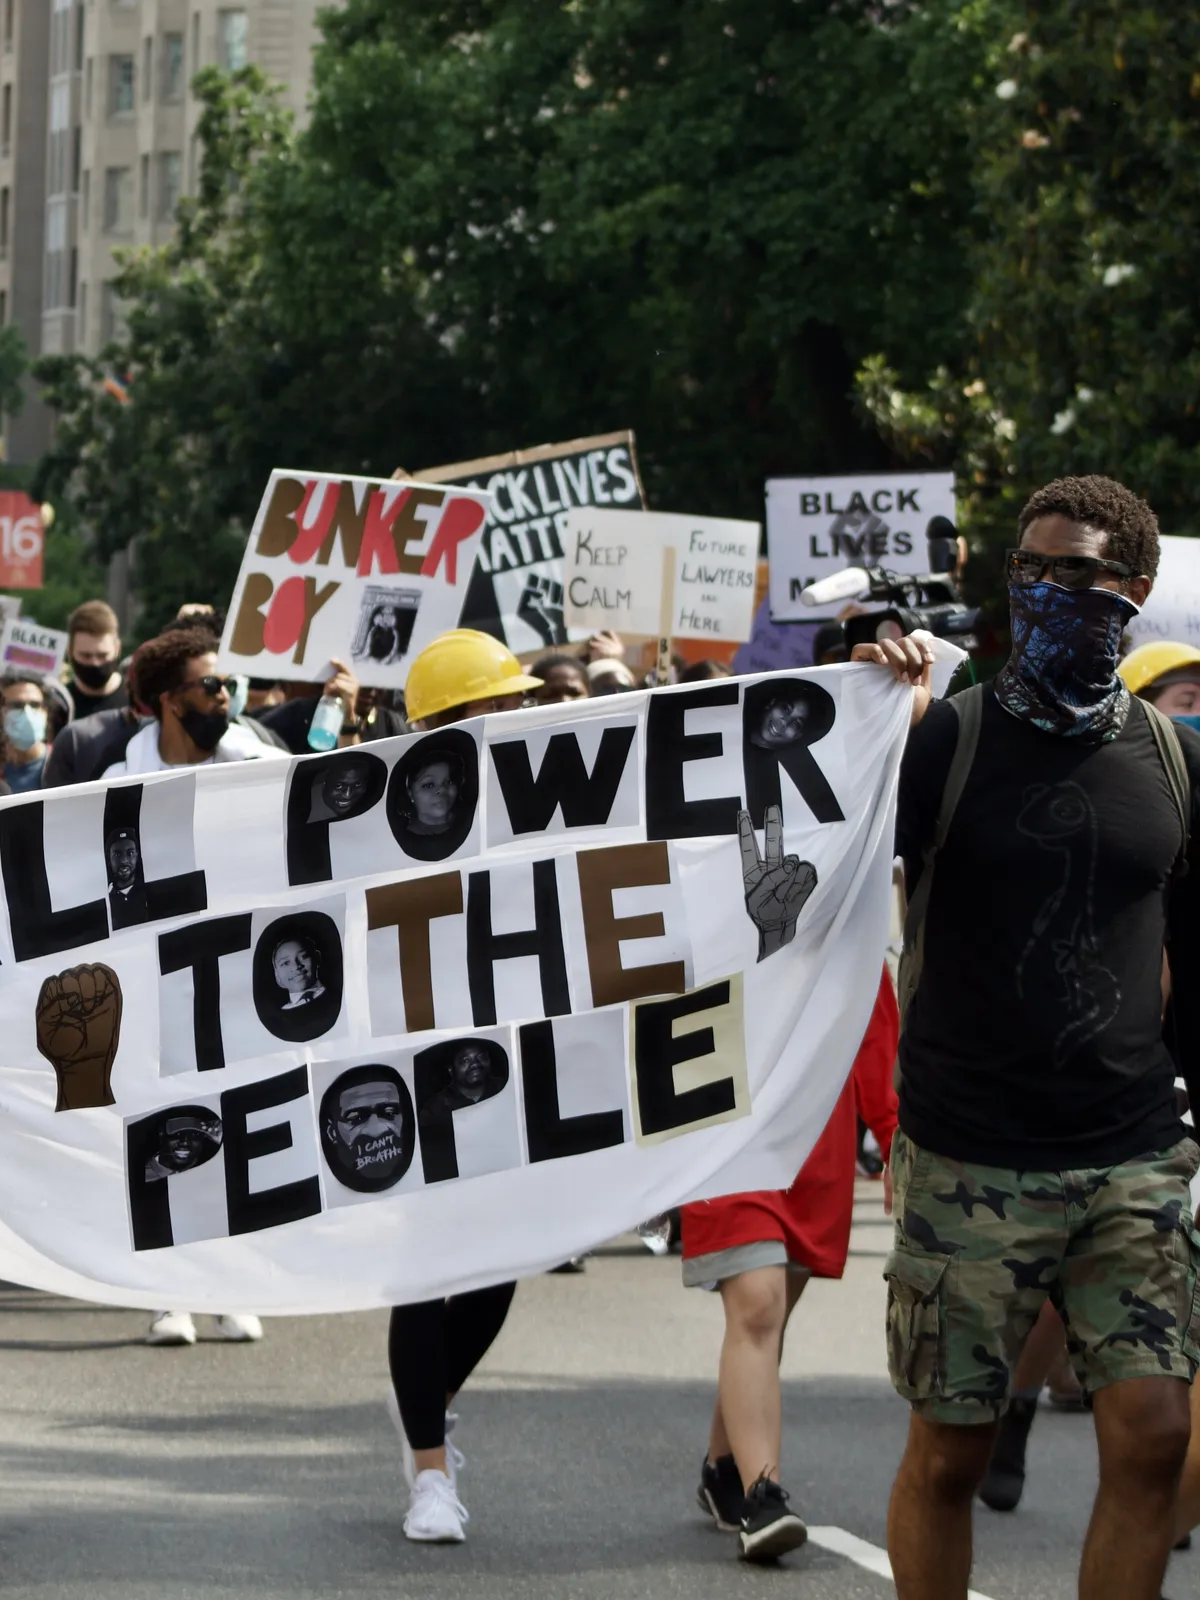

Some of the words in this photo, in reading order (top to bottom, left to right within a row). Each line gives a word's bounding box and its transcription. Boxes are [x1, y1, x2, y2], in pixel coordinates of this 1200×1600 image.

[533, 448, 637, 514] LIVES
[800, 488, 921, 516] BLACK
[256, 477, 487, 586] BUNKER
[575, 530, 628, 566] KEEP
[689, 530, 747, 557] FUTURE
[810, 530, 913, 559] LIVES
[681, 562, 754, 588] LAWYERS
[569, 577, 632, 611] CALM
[229, 572, 341, 666] BOY
[679, 607, 722, 632] HERE
[11, 626, 58, 650] BLACK
[286, 677, 846, 886] POWER
[158, 911, 346, 1071] TO
[365, 842, 686, 1032] THE
[127, 980, 736, 1252] PEOPLE
[357, 1144, 362, 1155] I
[365, 1134, 394, 1152] CAN'T
